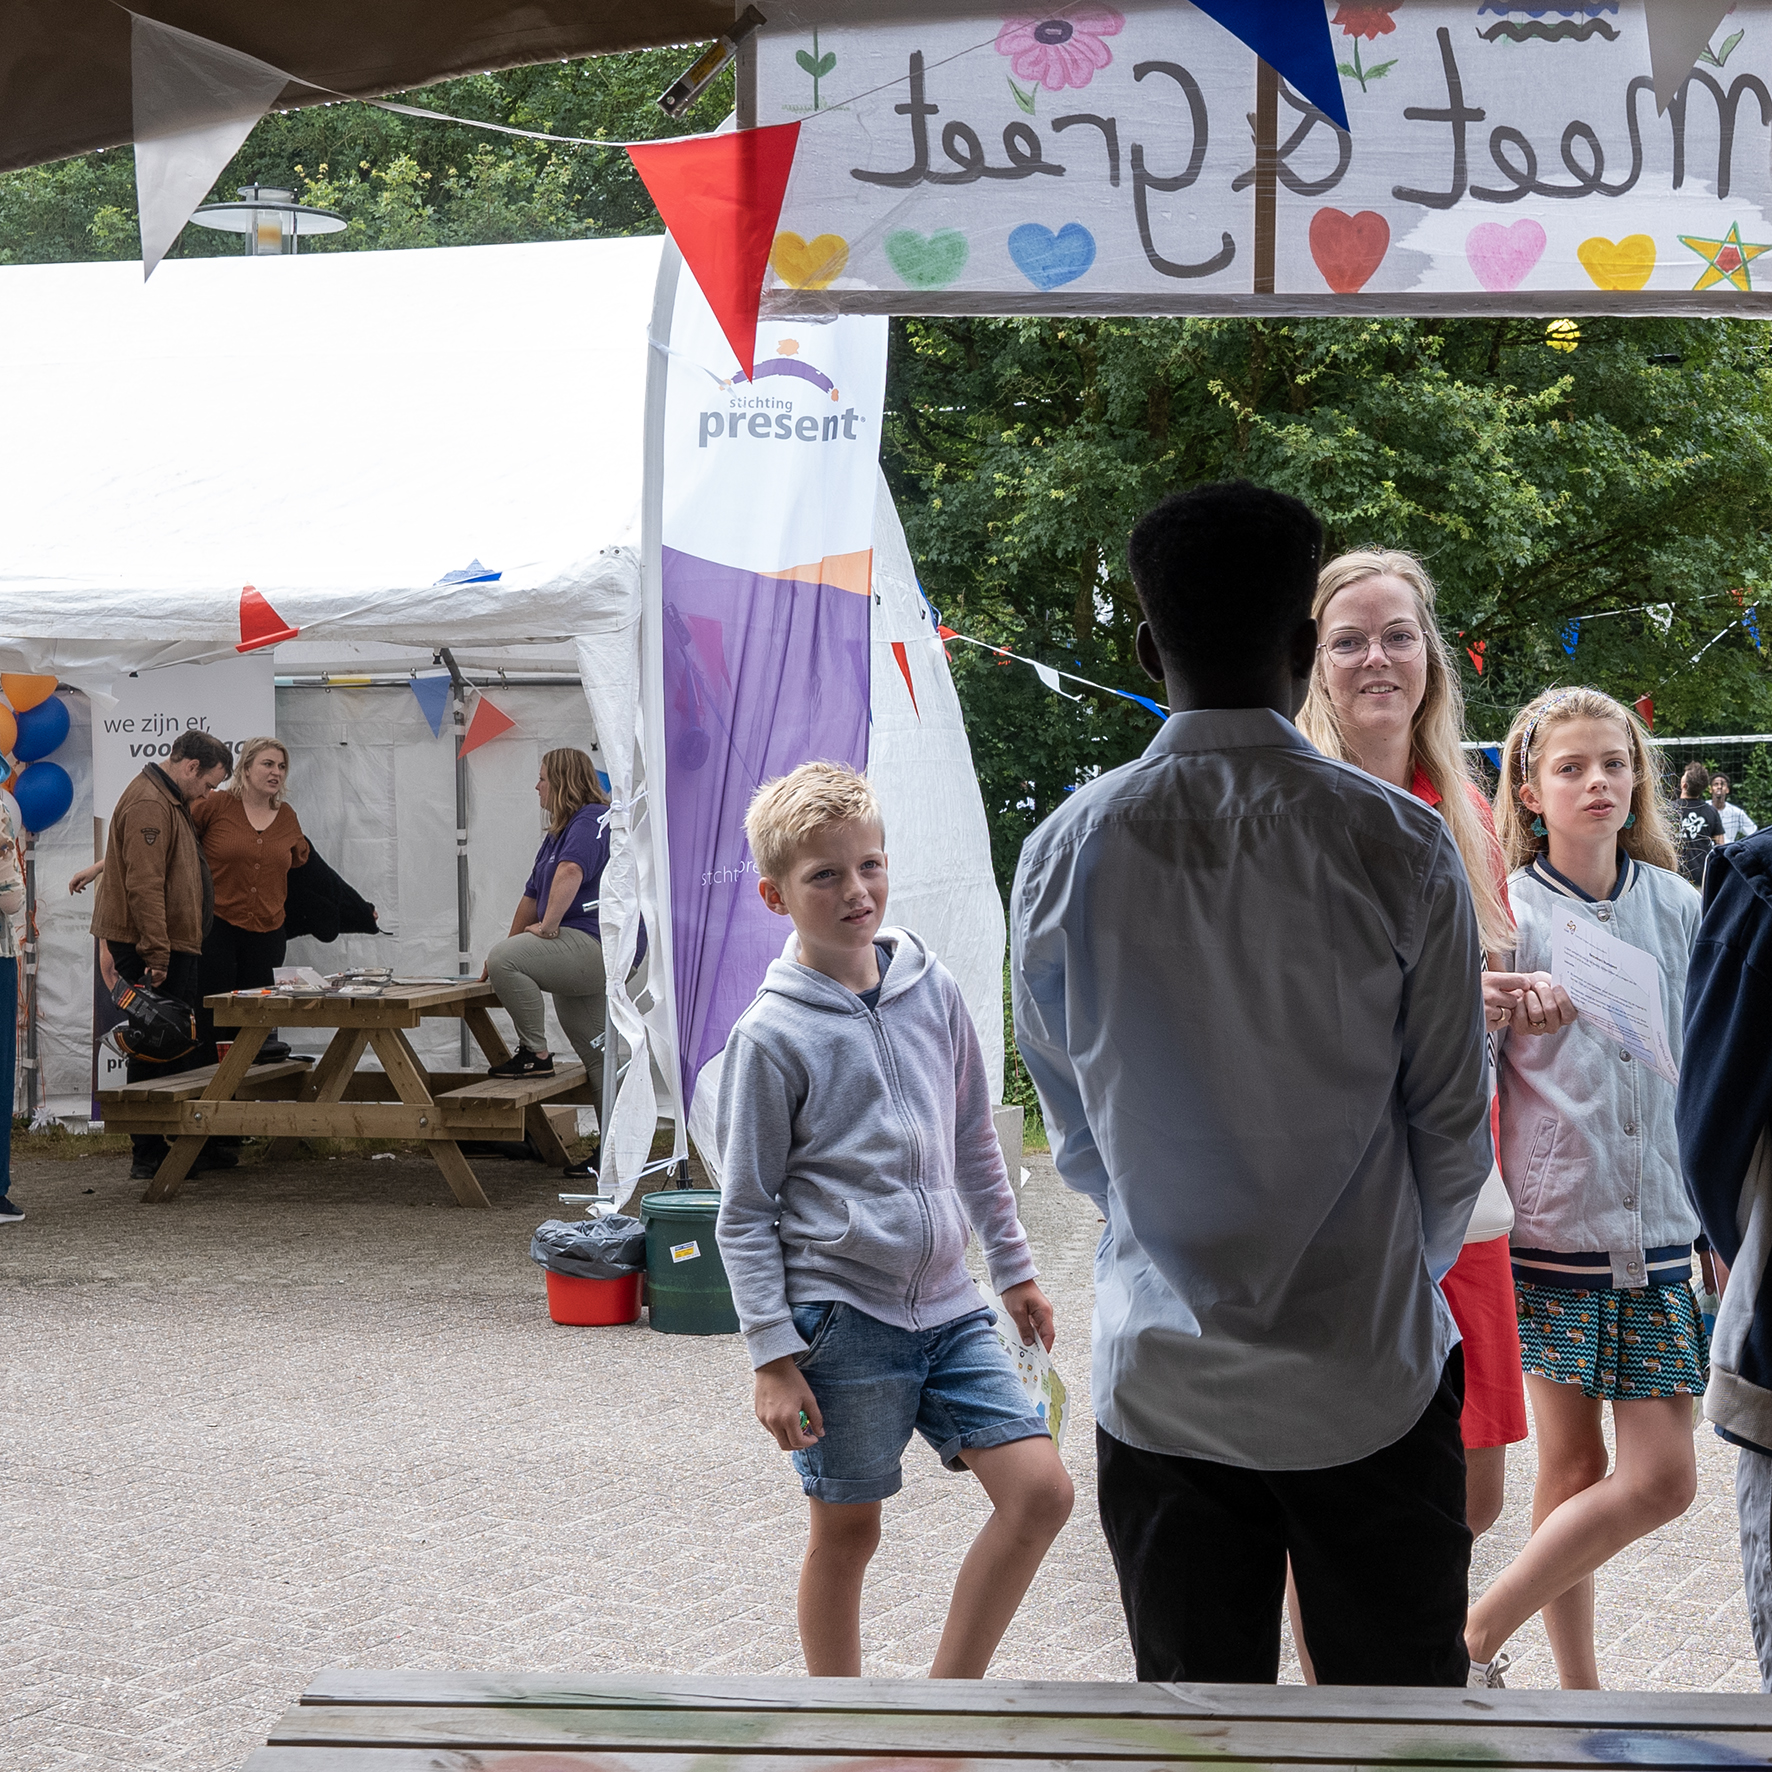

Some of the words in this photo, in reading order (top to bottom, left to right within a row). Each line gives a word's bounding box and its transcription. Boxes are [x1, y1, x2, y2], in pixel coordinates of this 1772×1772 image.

[729, 396, 793, 413] stichting
[103, 719, 135, 733] we
[141, 713, 179, 737] zijn
[186, 716, 211, 733] er,
[129, 743, 173, 758] voo
